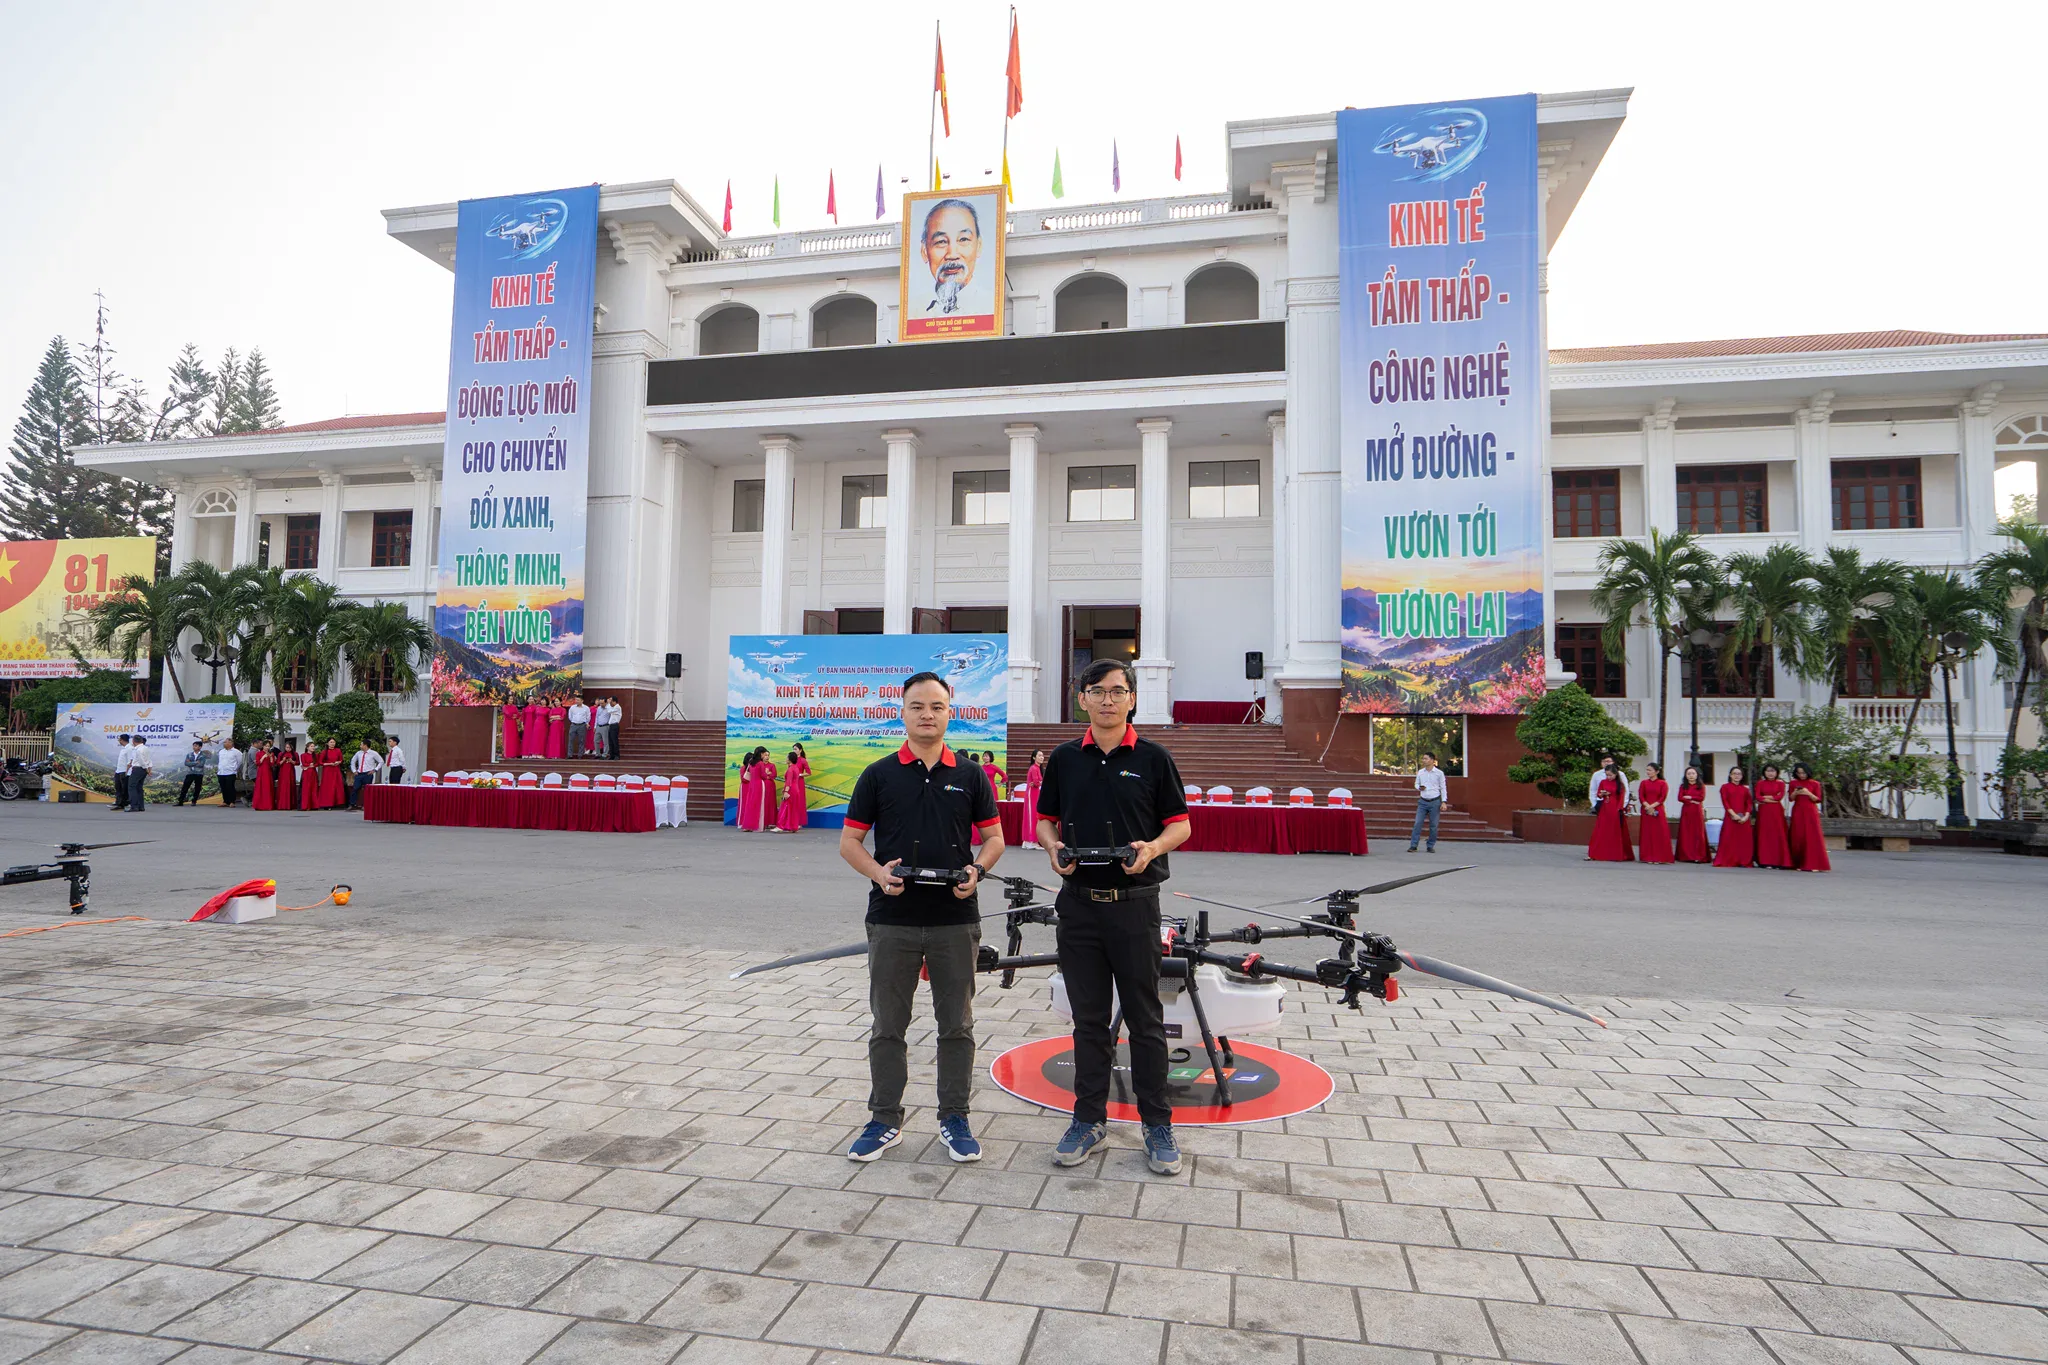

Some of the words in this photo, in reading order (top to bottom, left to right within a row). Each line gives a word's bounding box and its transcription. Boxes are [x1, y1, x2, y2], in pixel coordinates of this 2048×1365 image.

[1389, 201, 1449, 247] KINH
[1455, 182, 1486, 243] TẾ
[491, 275, 532, 308] KINH
[536, 261, 558, 304] TẾ
[1367, 265, 1420, 327] TẦM
[1428, 259, 1491, 323] THẤP
[474, 320, 509, 363] TẦM
[514, 316, 555, 361] THẤP
[1369, 349, 1435, 404] CÔNG
[1444, 341, 1510, 406] NGHỆ
[458, 380, 503, 425] ĐỘNG
[508, 381, 539, 423] LỰC
[544, 376, 578, 415] MỚI
[462, 441, 495, 474] CHO
[501, 426, 567, 472] CHUYỂN
[1366, 422, 1405, 482] MỞ
[1412, 424, 1497, 480] ĐƯỜNG
[470, 485, 498, 529] ĐỔI
[502, 496, 554, 532] XANH,
[1384, 510, 1449, 559] VƯƠN
[1458, 503, 1497, 558] TỚI
[65, 554, 108, 593] 81
[456, 547, 508, 587] THÔNG
[514, 553, 566, 590] MINH,
[465, 600, 500, 645] BỀN
[504, 605, 552, 645] VỮNG
[1377, 589, 1460, 639] TƯƠNG
[1466, 591, 1507, 638] LAI
[776, 686, 800, 698] KINH
[803, 682, 816, 698] TẾ
[843, 682, 868, 698] THẤP
[826, 666, 839, 674] BAN
[840, 665, 856, 674] NHÂN
[104, 725, 135, 733] SMART
[137, 724, 184, 733] LOGISTICS
[744, 706, 764, 718] CHO
[767, 702, 806, 718] CHUYỂN
[809, 702, 827, 718] ĐỔI
[830, 706, 860, 720] XANH,
[863, 704, 897, 719] THÔNG
[959, 705, 988, 720] VỮNG
